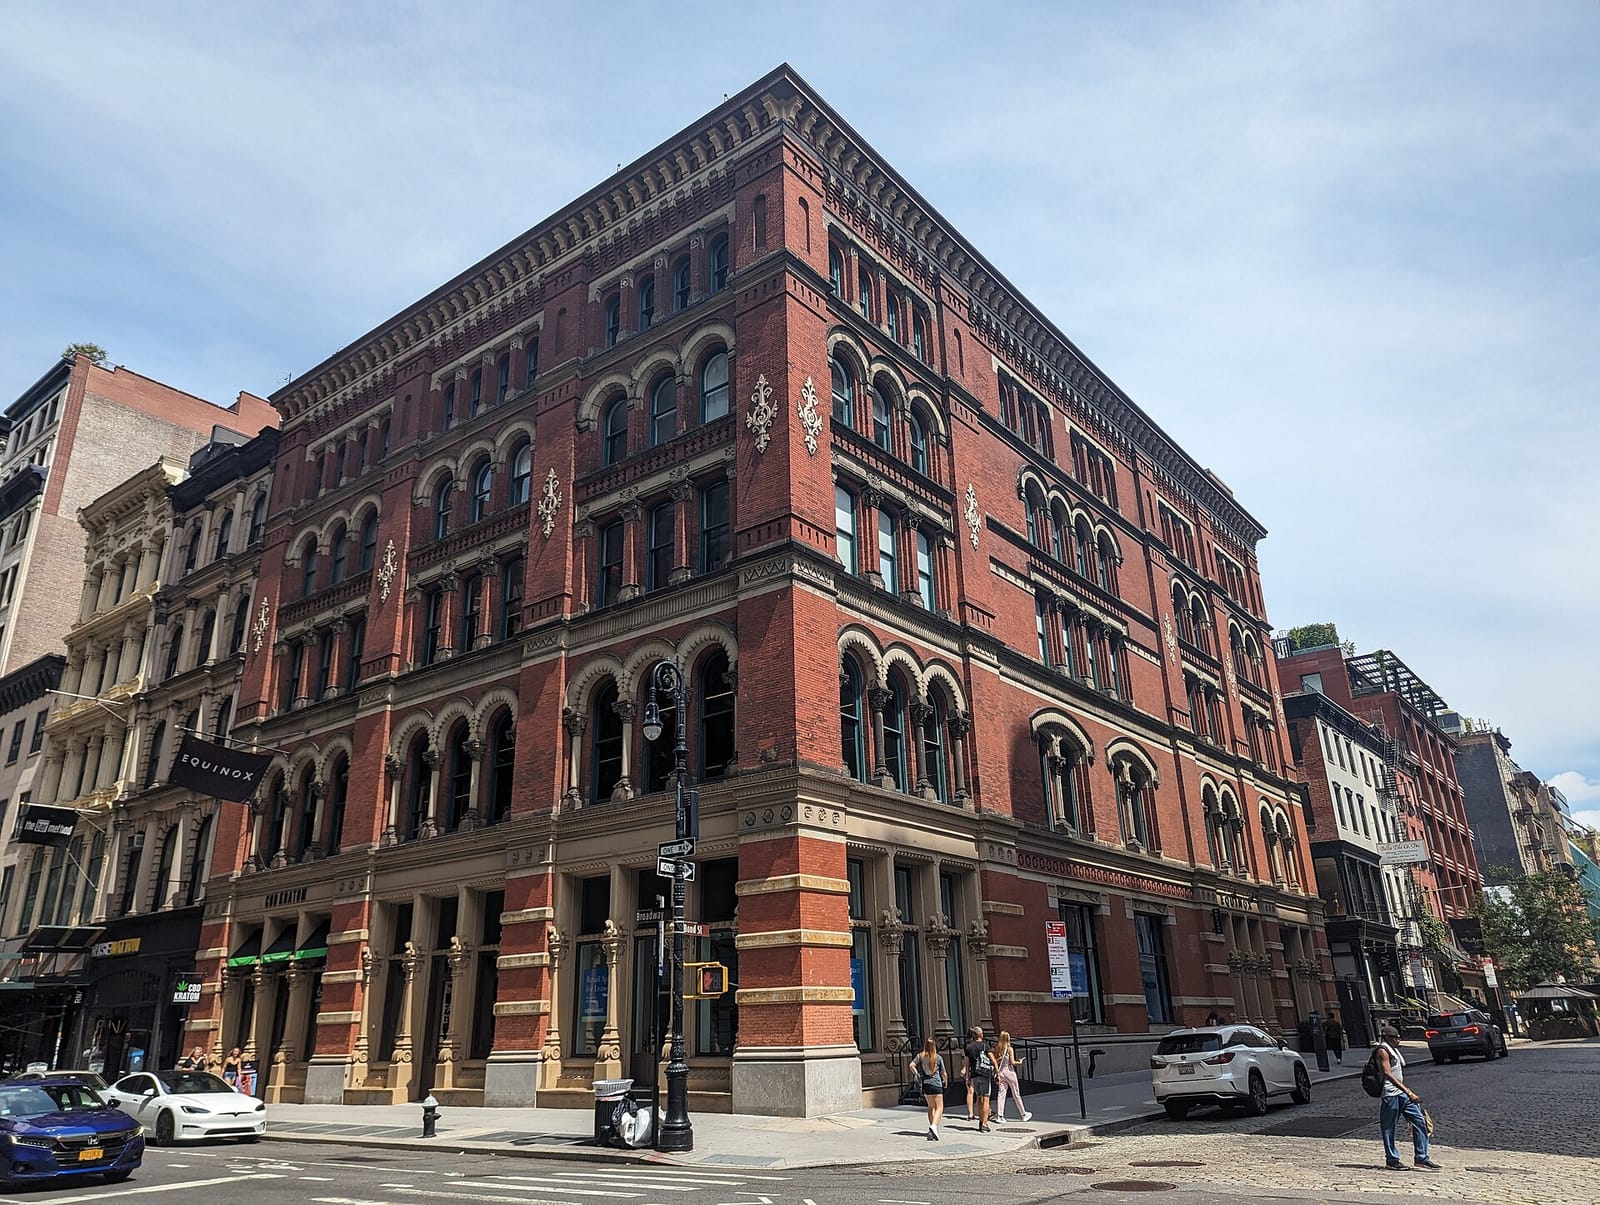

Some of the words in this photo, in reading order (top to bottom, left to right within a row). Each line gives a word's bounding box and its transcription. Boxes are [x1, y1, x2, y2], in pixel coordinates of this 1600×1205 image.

[181, 753, 254, 781] EQUINOX
[662, 846, 674, 855] ONE
[678, 843, 690, 852] WAY
[1220, 894, 1253, 912] EQUINOX
[636, 910, 665, 921] Broadway
[697, 925, 703, 935] St
[188, 984, 202, 992] CBD
[173, 992, 201, 1001] KRATOM
